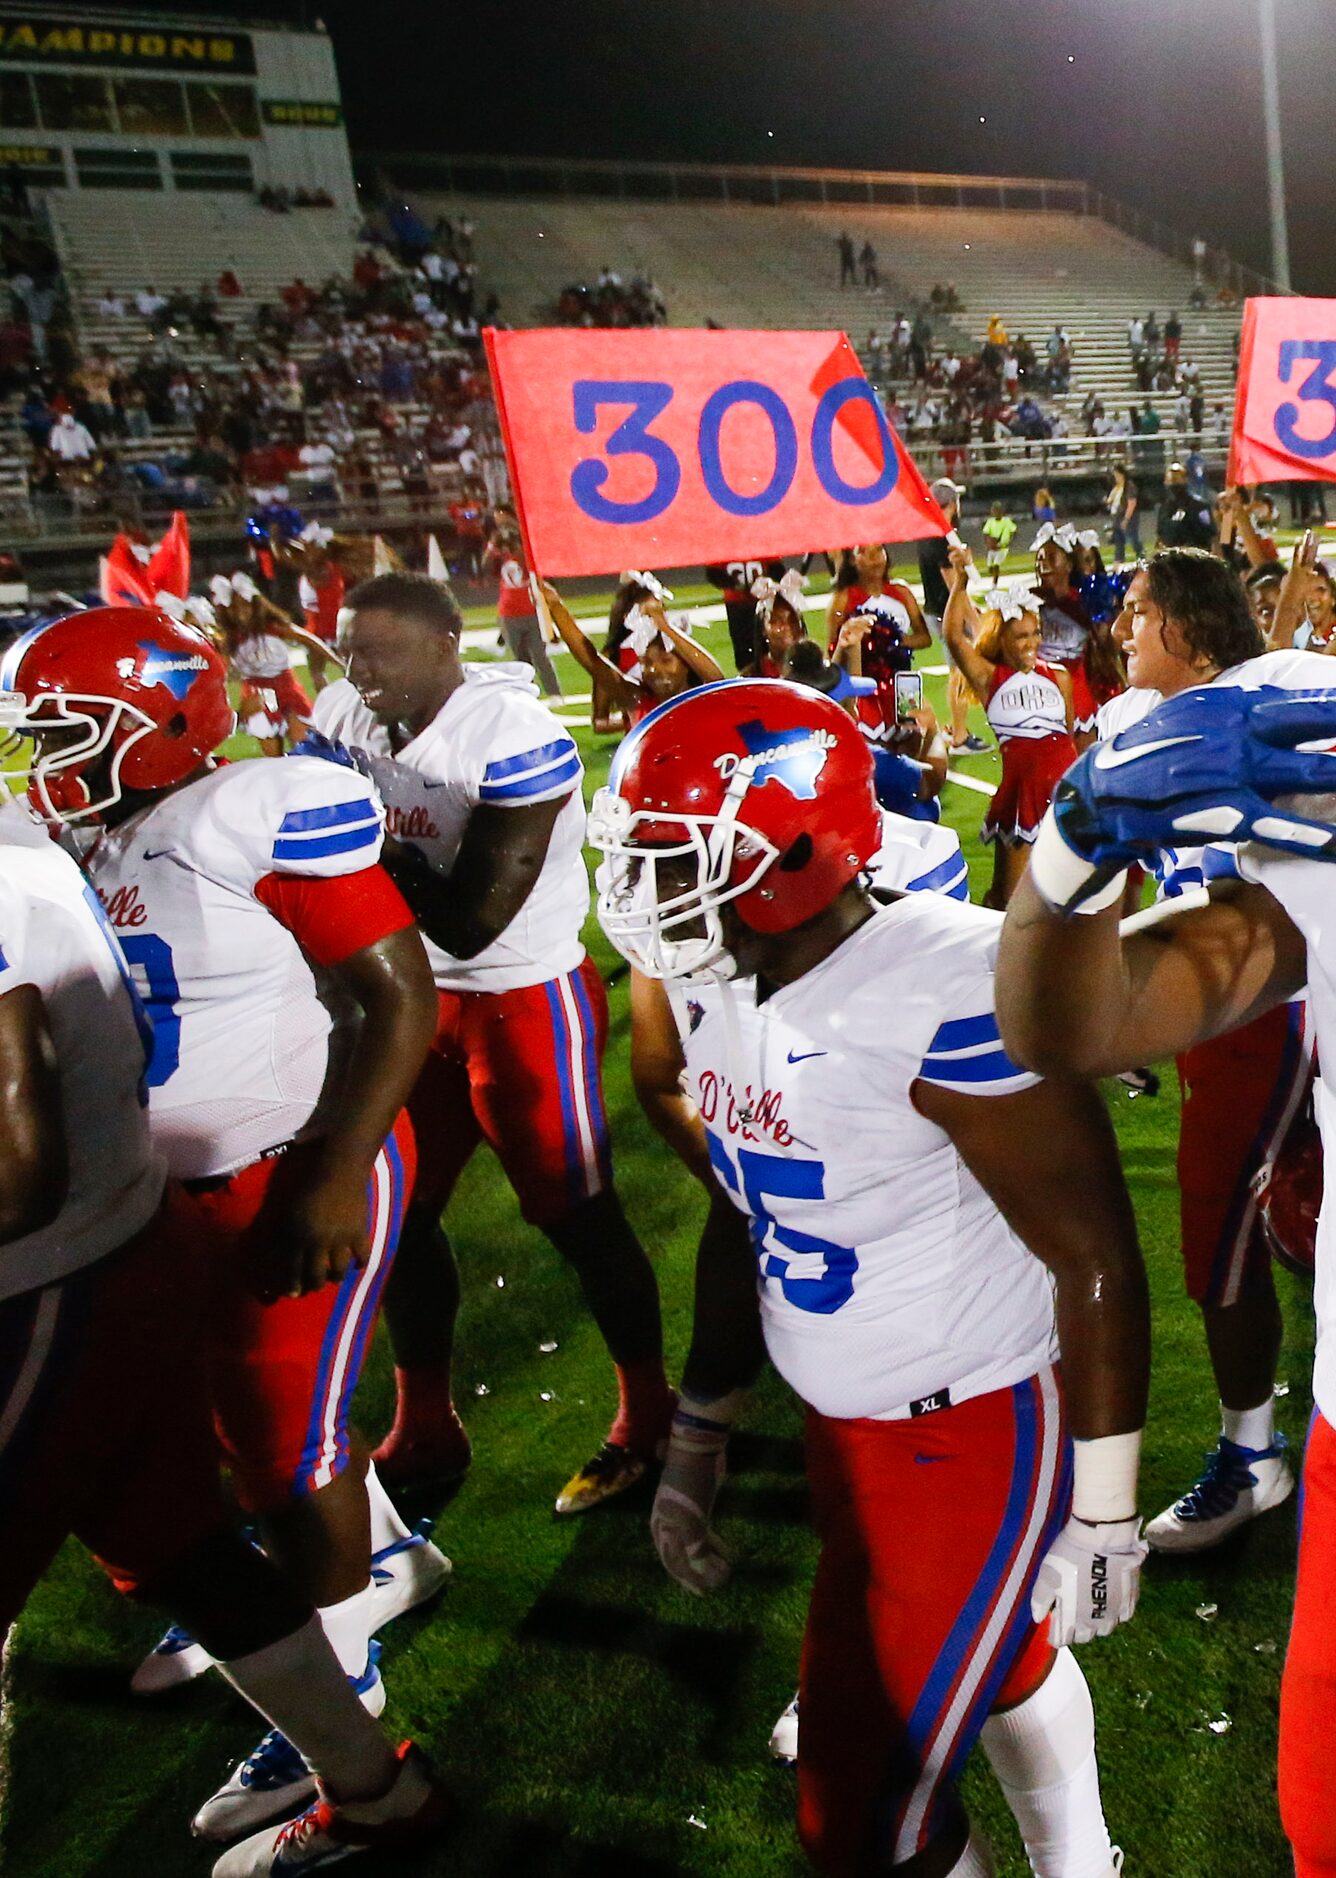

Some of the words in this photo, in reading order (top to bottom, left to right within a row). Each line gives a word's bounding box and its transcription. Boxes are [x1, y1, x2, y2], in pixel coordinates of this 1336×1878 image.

[0, 22, 235, 62] AMPIONS
[570, 376, 899, 524] 300
[1001, 684, 1061, 712] DHS
[920, 1396, 941, 1414] XL
